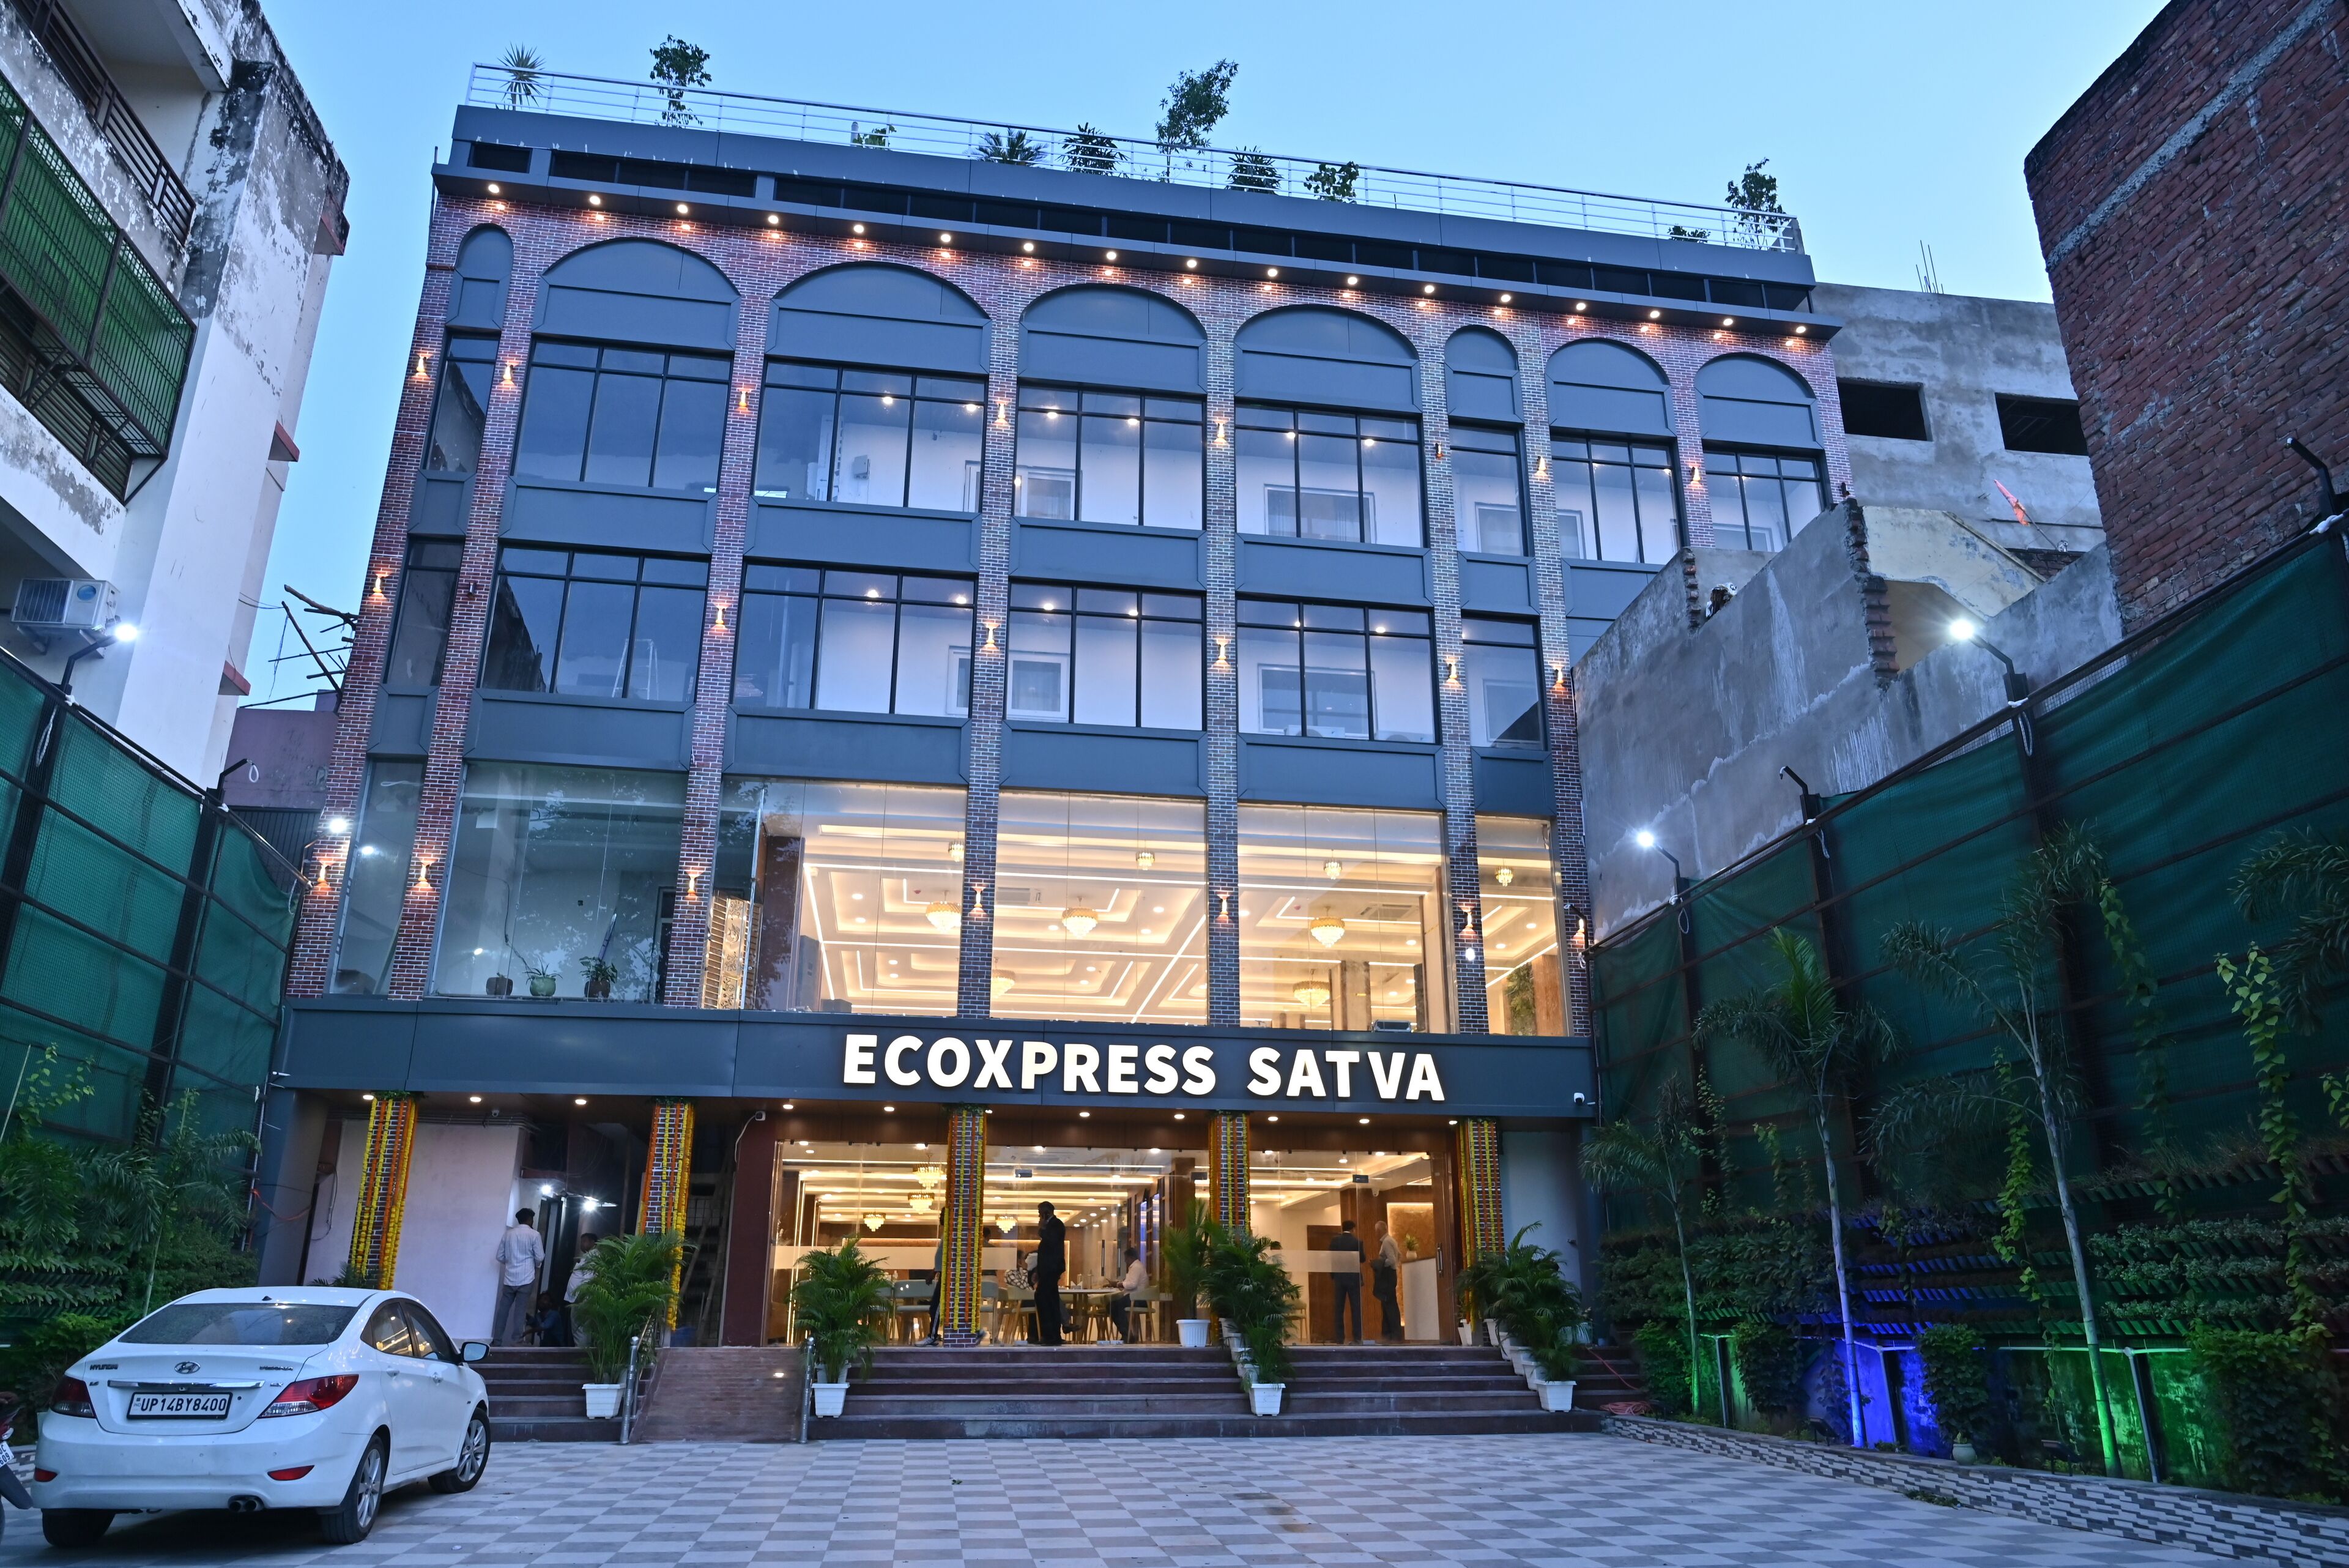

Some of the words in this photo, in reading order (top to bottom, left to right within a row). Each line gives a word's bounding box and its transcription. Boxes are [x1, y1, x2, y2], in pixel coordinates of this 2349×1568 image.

[844, 1034, 1216, 1095] ECOXPRESS
[1247, 1047, 1445, 1101] SATVA
[141, 1398, 227, 1411] UP14BY8400
